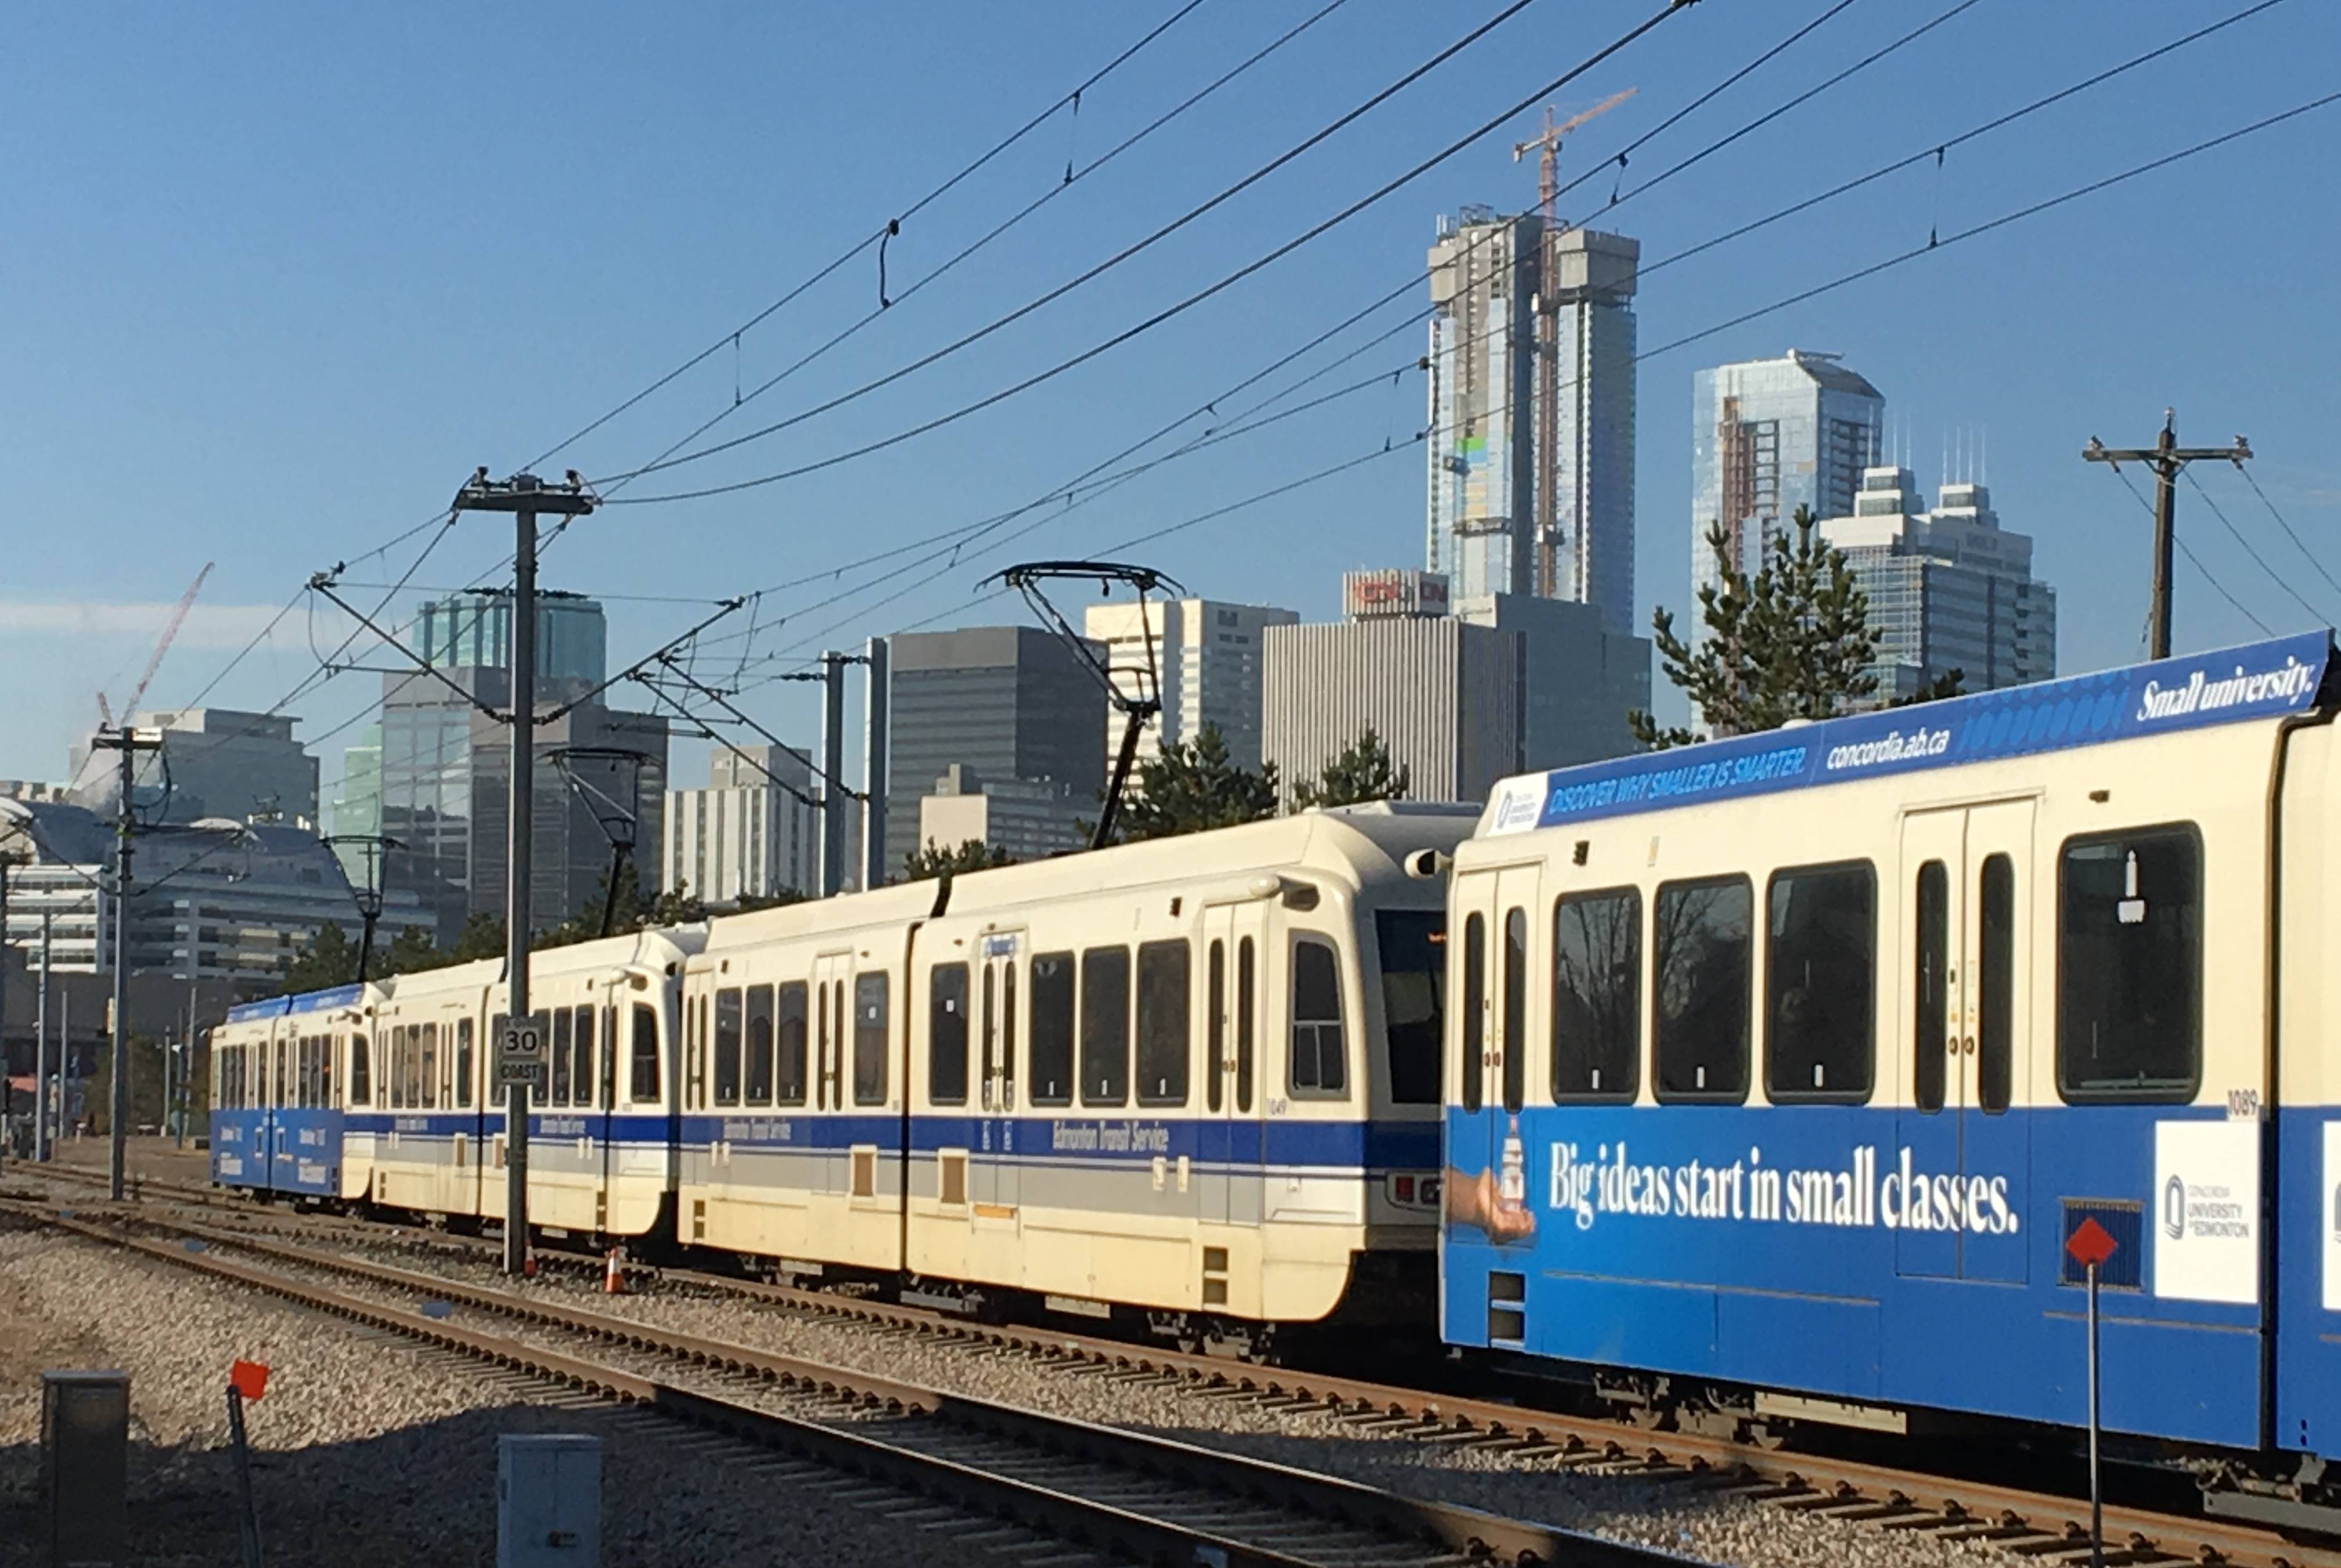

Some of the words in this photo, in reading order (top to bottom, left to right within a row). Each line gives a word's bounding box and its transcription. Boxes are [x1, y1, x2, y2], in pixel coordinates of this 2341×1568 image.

[2137, 671, 2205, 721] Small
[2199, 655, 2315, 705] university.
[1827, 727, 1950, 769] concordia.ab.ca
[1549, 779, 1618, 814] DISCOVER
[1616, 773, 1652, 803] WHY
[1648, 762, 1716, 799] SMALLER
[1713, 760, 1733, 788] IS
[505, 1030, 536, 1051] 30
[501, 1064, 538, 1079] COAST
[2227, 1089, 2257, 1116] 1089
[1053, 1120, 1097, 1151] Edmonton
[1100, 1120, 1130, 1152] Transit
[1132, 1120, 1169, 1152] Service
[1550, 1142, 1594, 1230] Big
[1598, 1141, 1670, 1216] ideas
[1675, 1159, 1744, 1220] start
[1750, 1146, 1780, 1220] in
[1786, 1145, 1875, 1226] small
[1881, 1146, 2018, 1234] classes.
